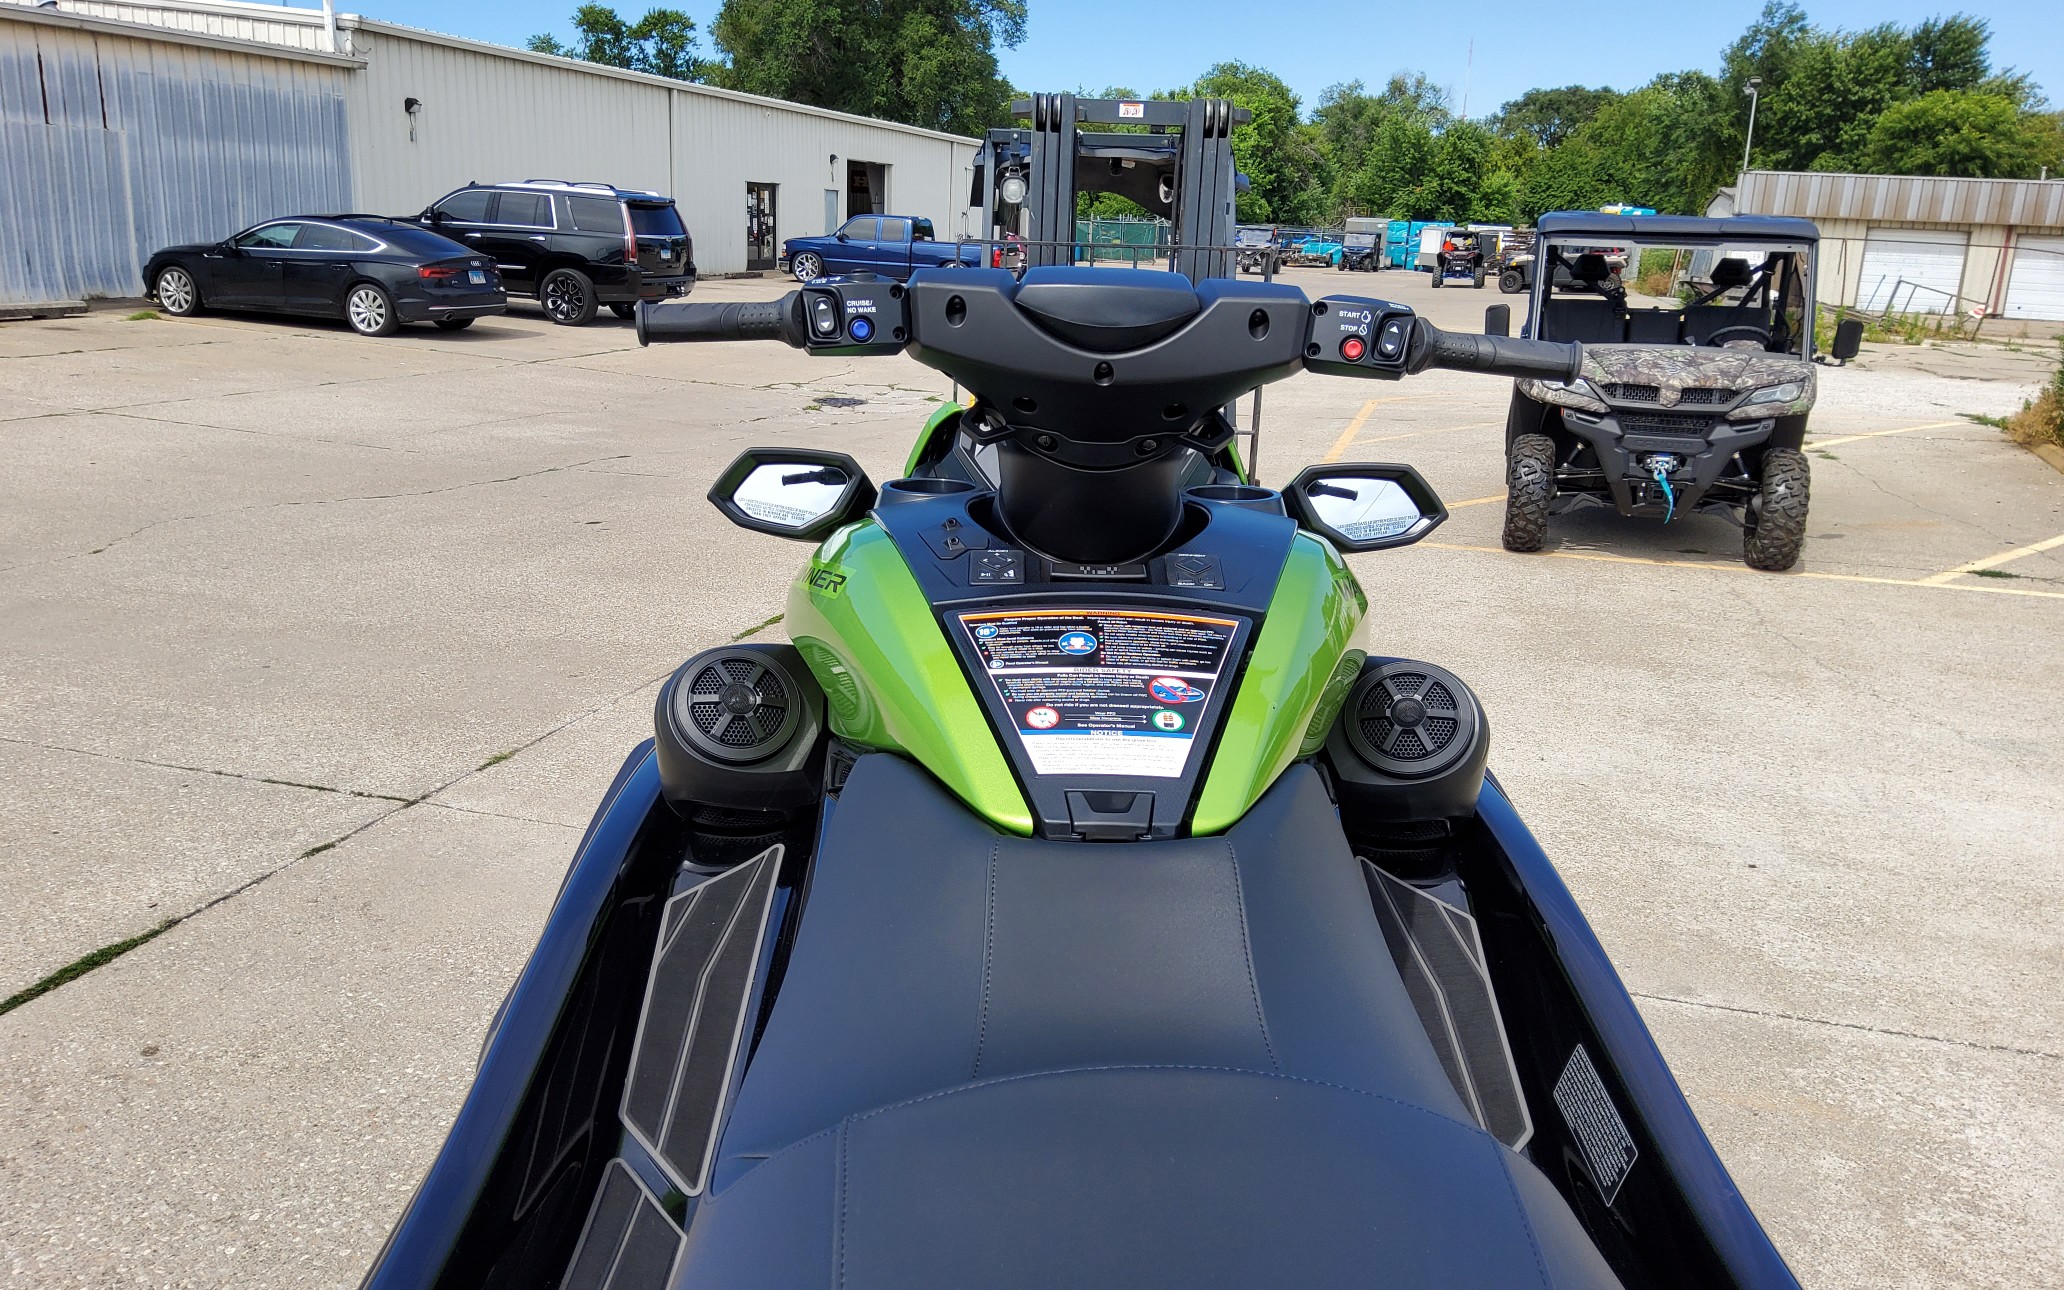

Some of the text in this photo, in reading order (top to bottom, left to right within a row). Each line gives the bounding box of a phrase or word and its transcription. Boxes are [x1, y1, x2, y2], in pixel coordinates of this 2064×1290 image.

[846, 299, 873, 307] CRUISE/
[1338, 310, 1361, 319] START
[1340, 324, 1358, 332] STOP
